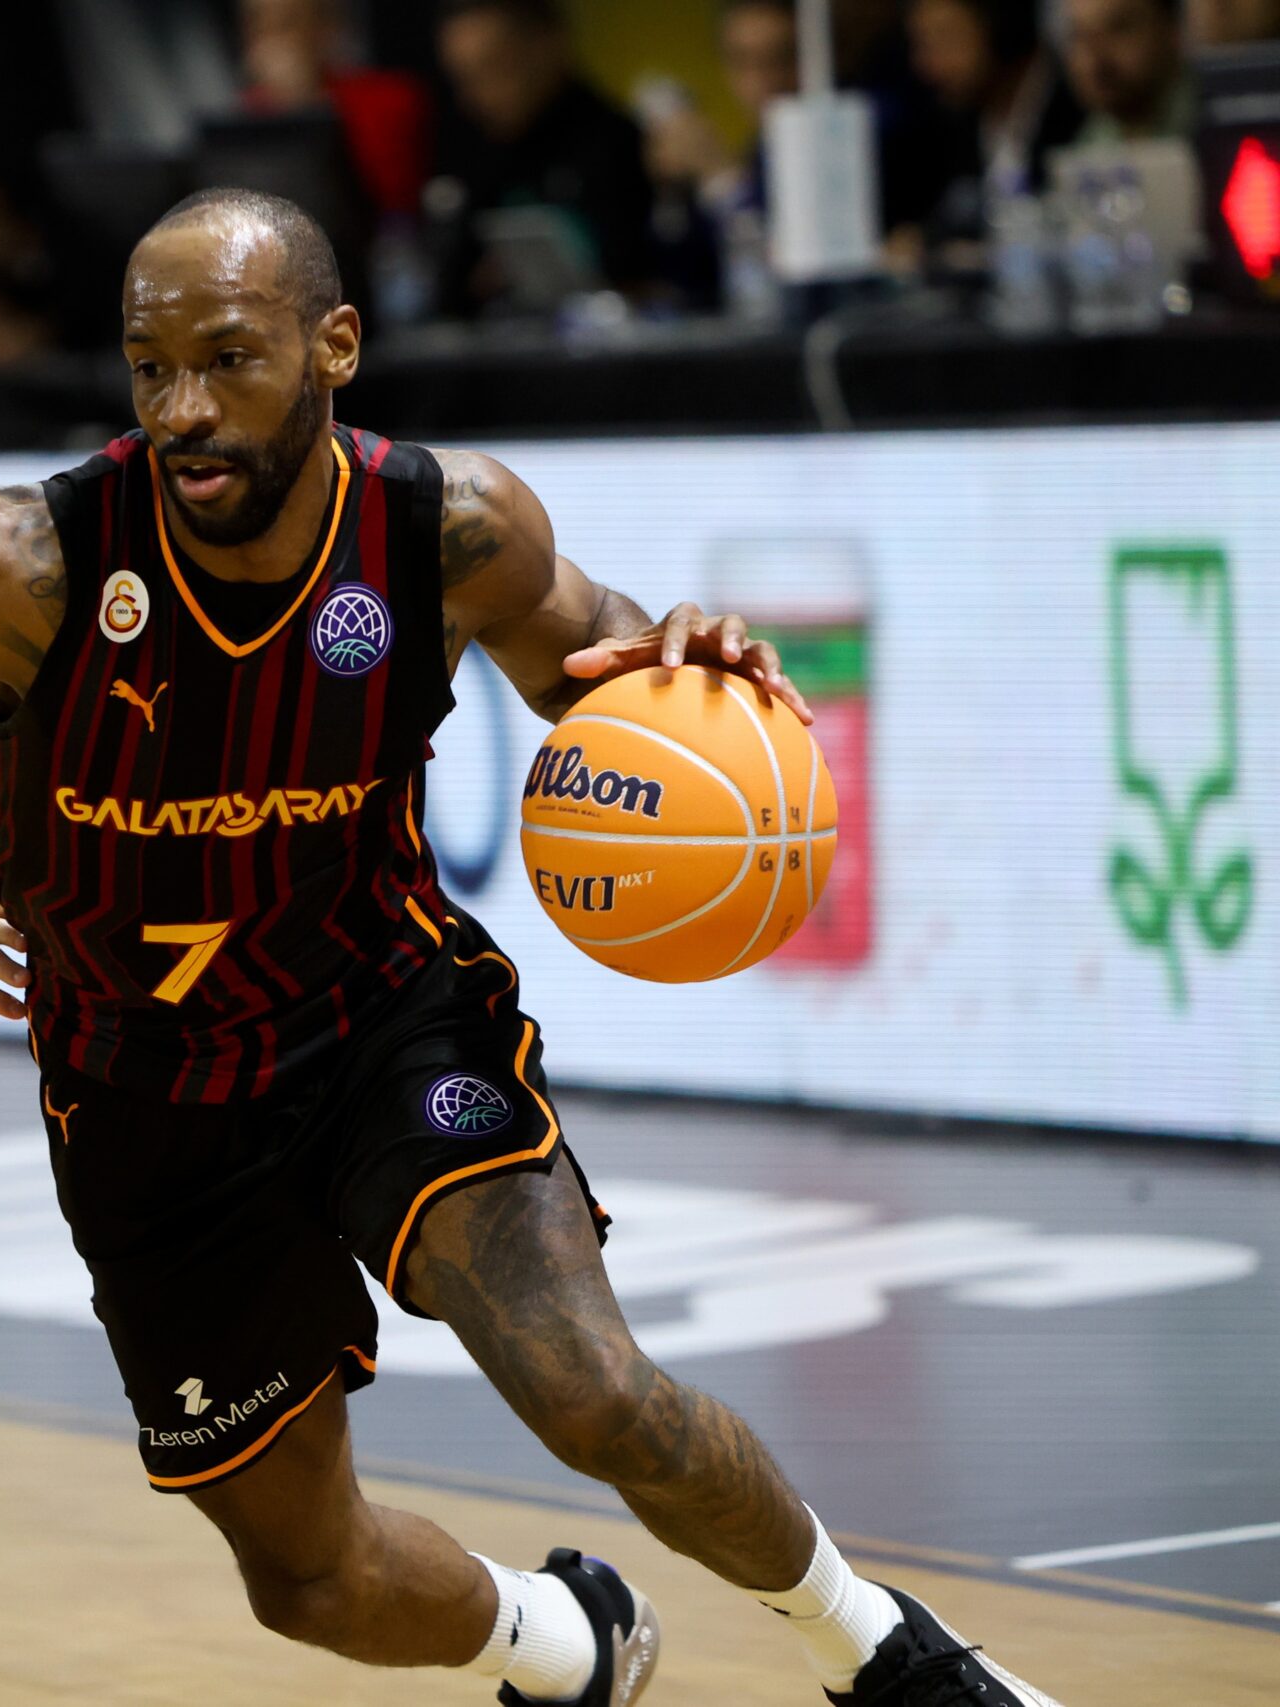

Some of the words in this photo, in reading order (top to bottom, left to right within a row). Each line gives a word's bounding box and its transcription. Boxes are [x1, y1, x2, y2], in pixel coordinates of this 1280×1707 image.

[55, 778, 386, 838] GALATASARAY
[618, 869, 657, 889] NXT
[142, 921, 234, 1005] 7
[140, 1426, 216, 1447] Zeren
[213, 1371, 290, 1433] Metal
